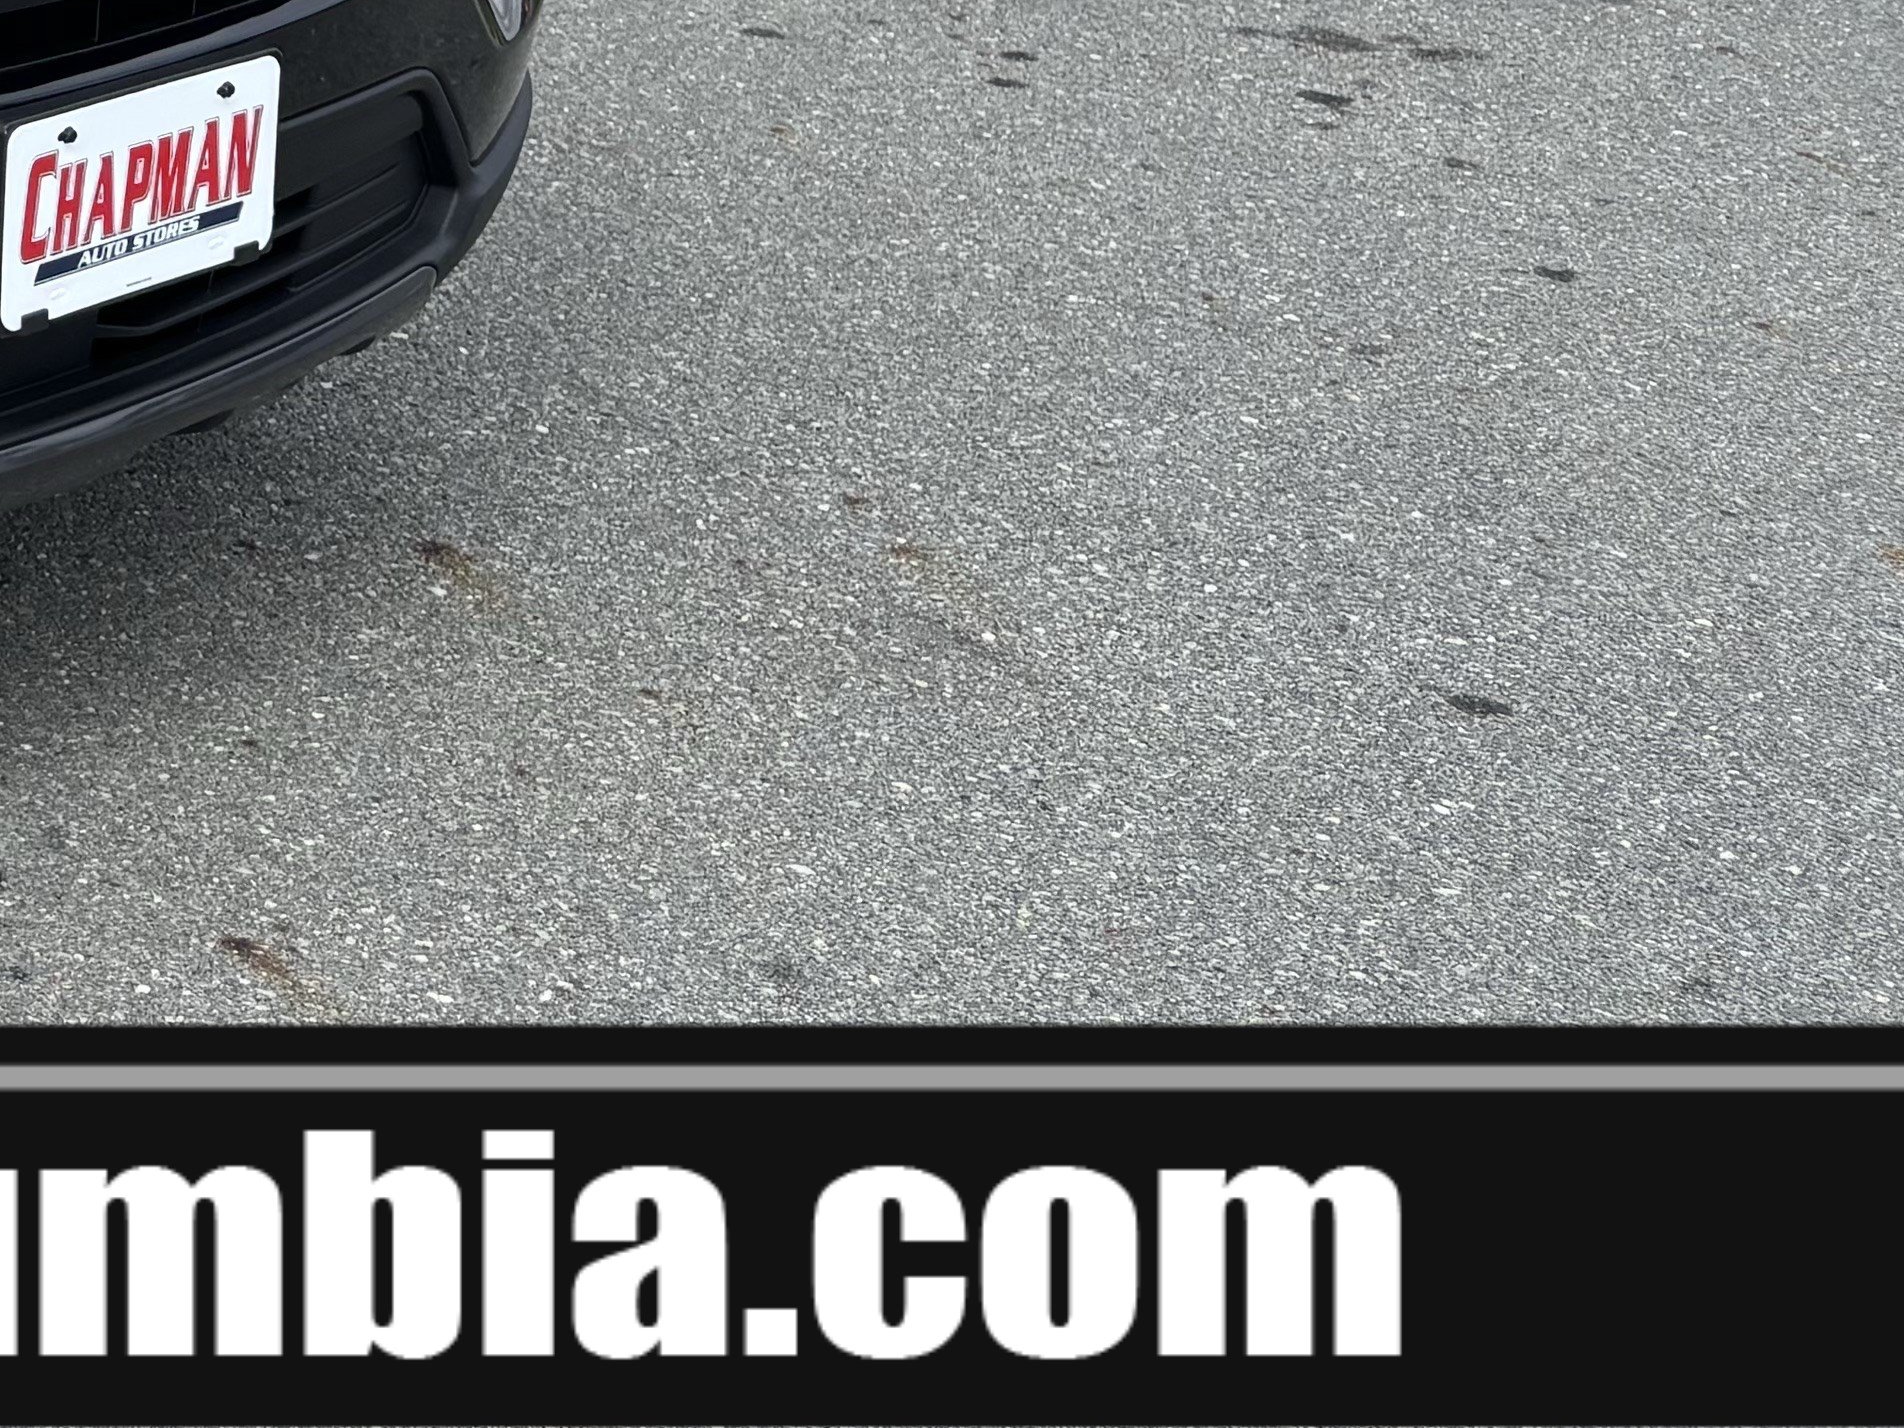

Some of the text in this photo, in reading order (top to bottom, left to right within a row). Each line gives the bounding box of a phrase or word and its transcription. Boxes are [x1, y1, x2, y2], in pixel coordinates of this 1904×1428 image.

[20, 104, 264, 265] CHAPMAN
[77, 214, 201, 269] AUTO STORES
